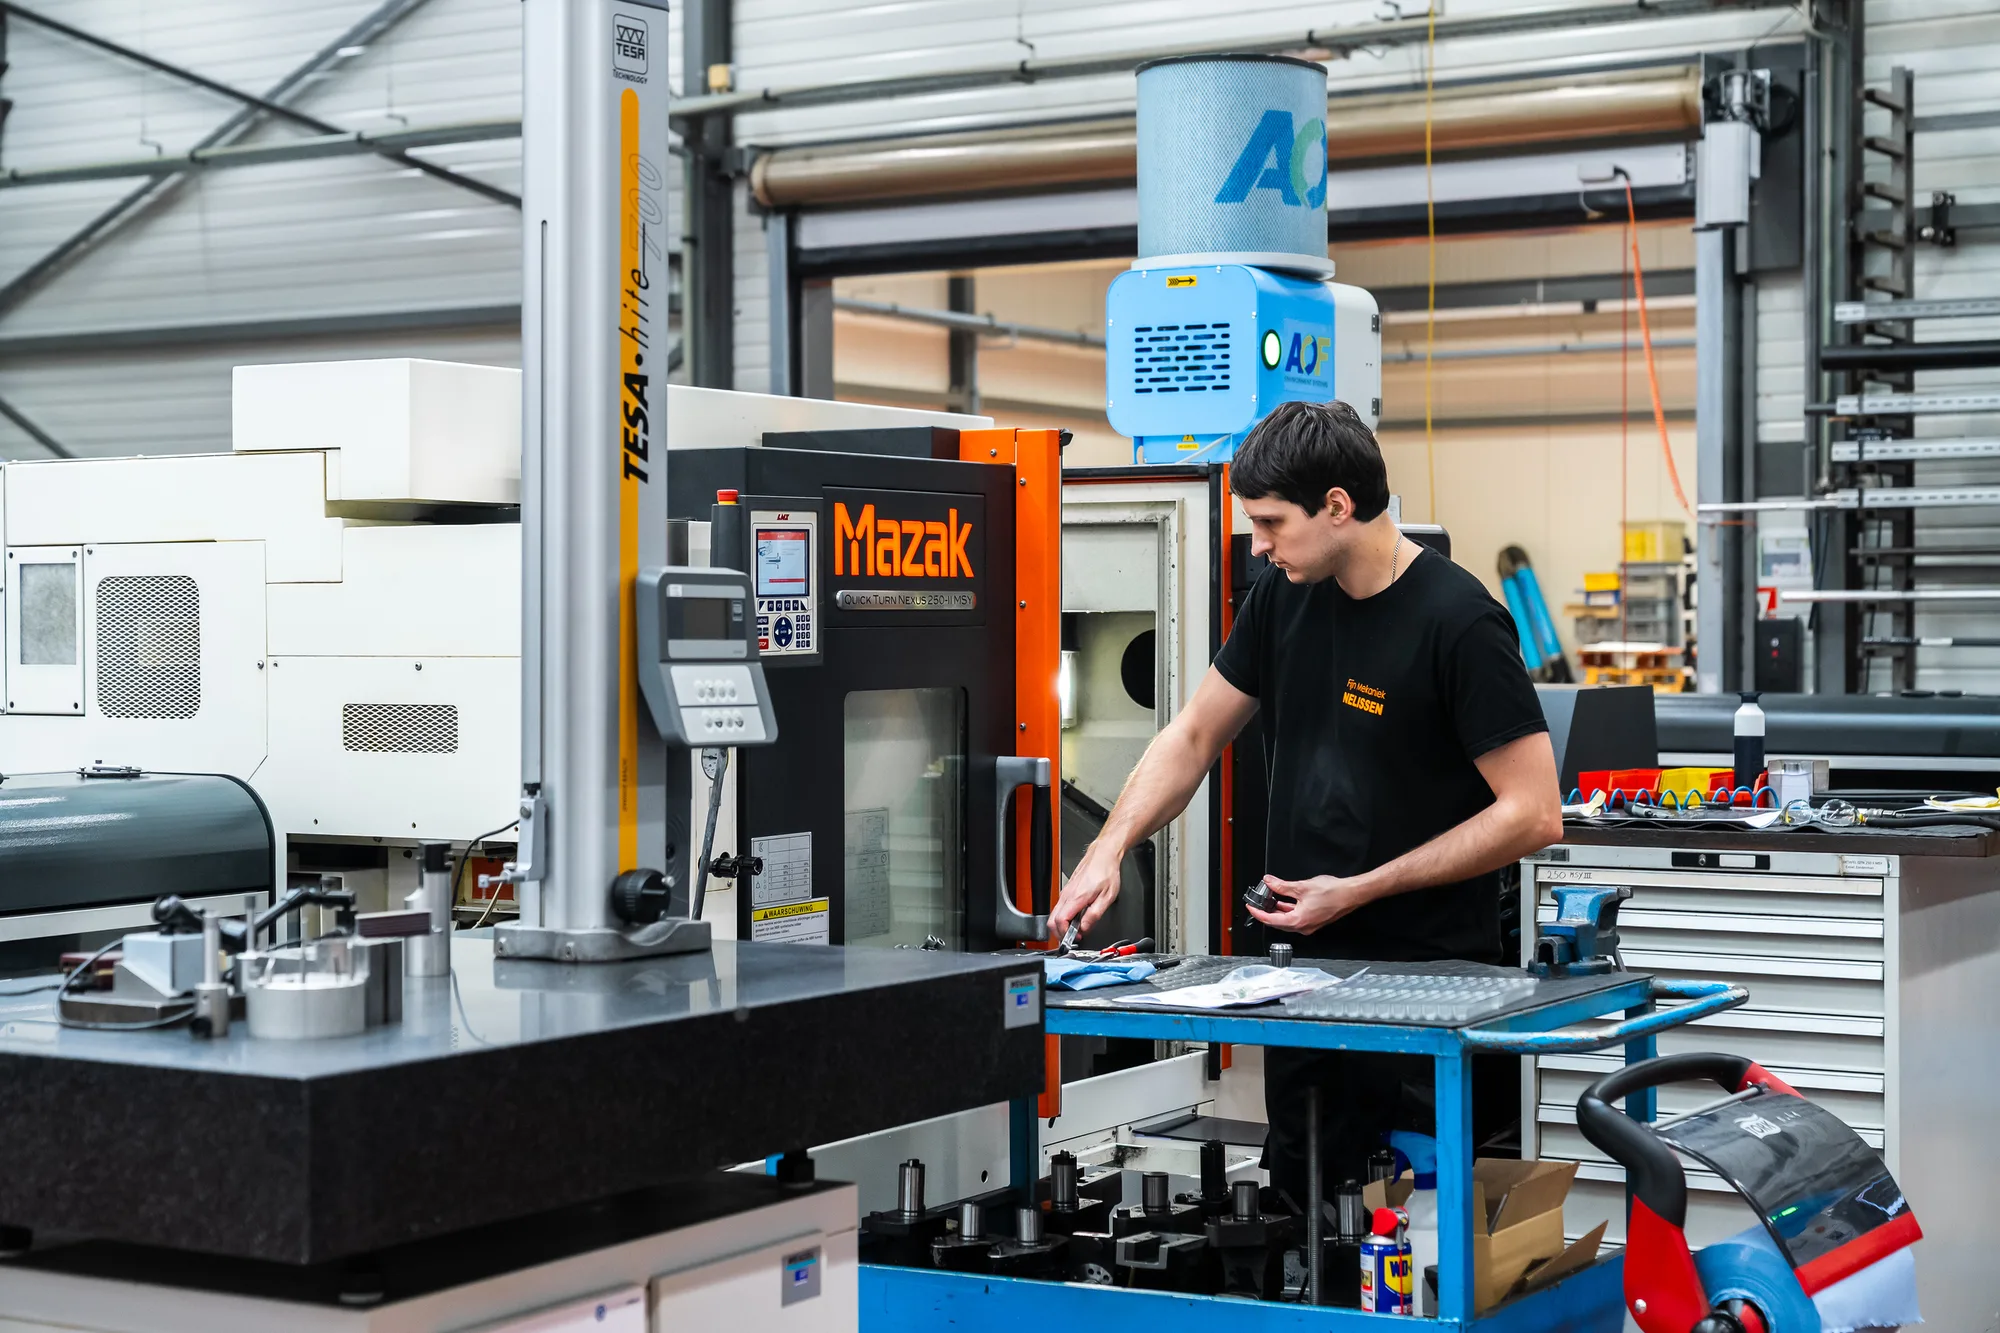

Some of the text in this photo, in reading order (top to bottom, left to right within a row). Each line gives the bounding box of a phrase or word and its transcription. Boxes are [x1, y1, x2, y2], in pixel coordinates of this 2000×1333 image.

[616, 42, 645, 61] TESA
[629, 153, 662, 261] 700
[1285, 332, 1331, 377] AOF
[834, 502, 975, 578] Mazak
[1342, 691, 1384, 715] NELISSEN
[1547, 870, 1566, 880] 250
[768, 904, 814, 918] WAARSCHUWING
